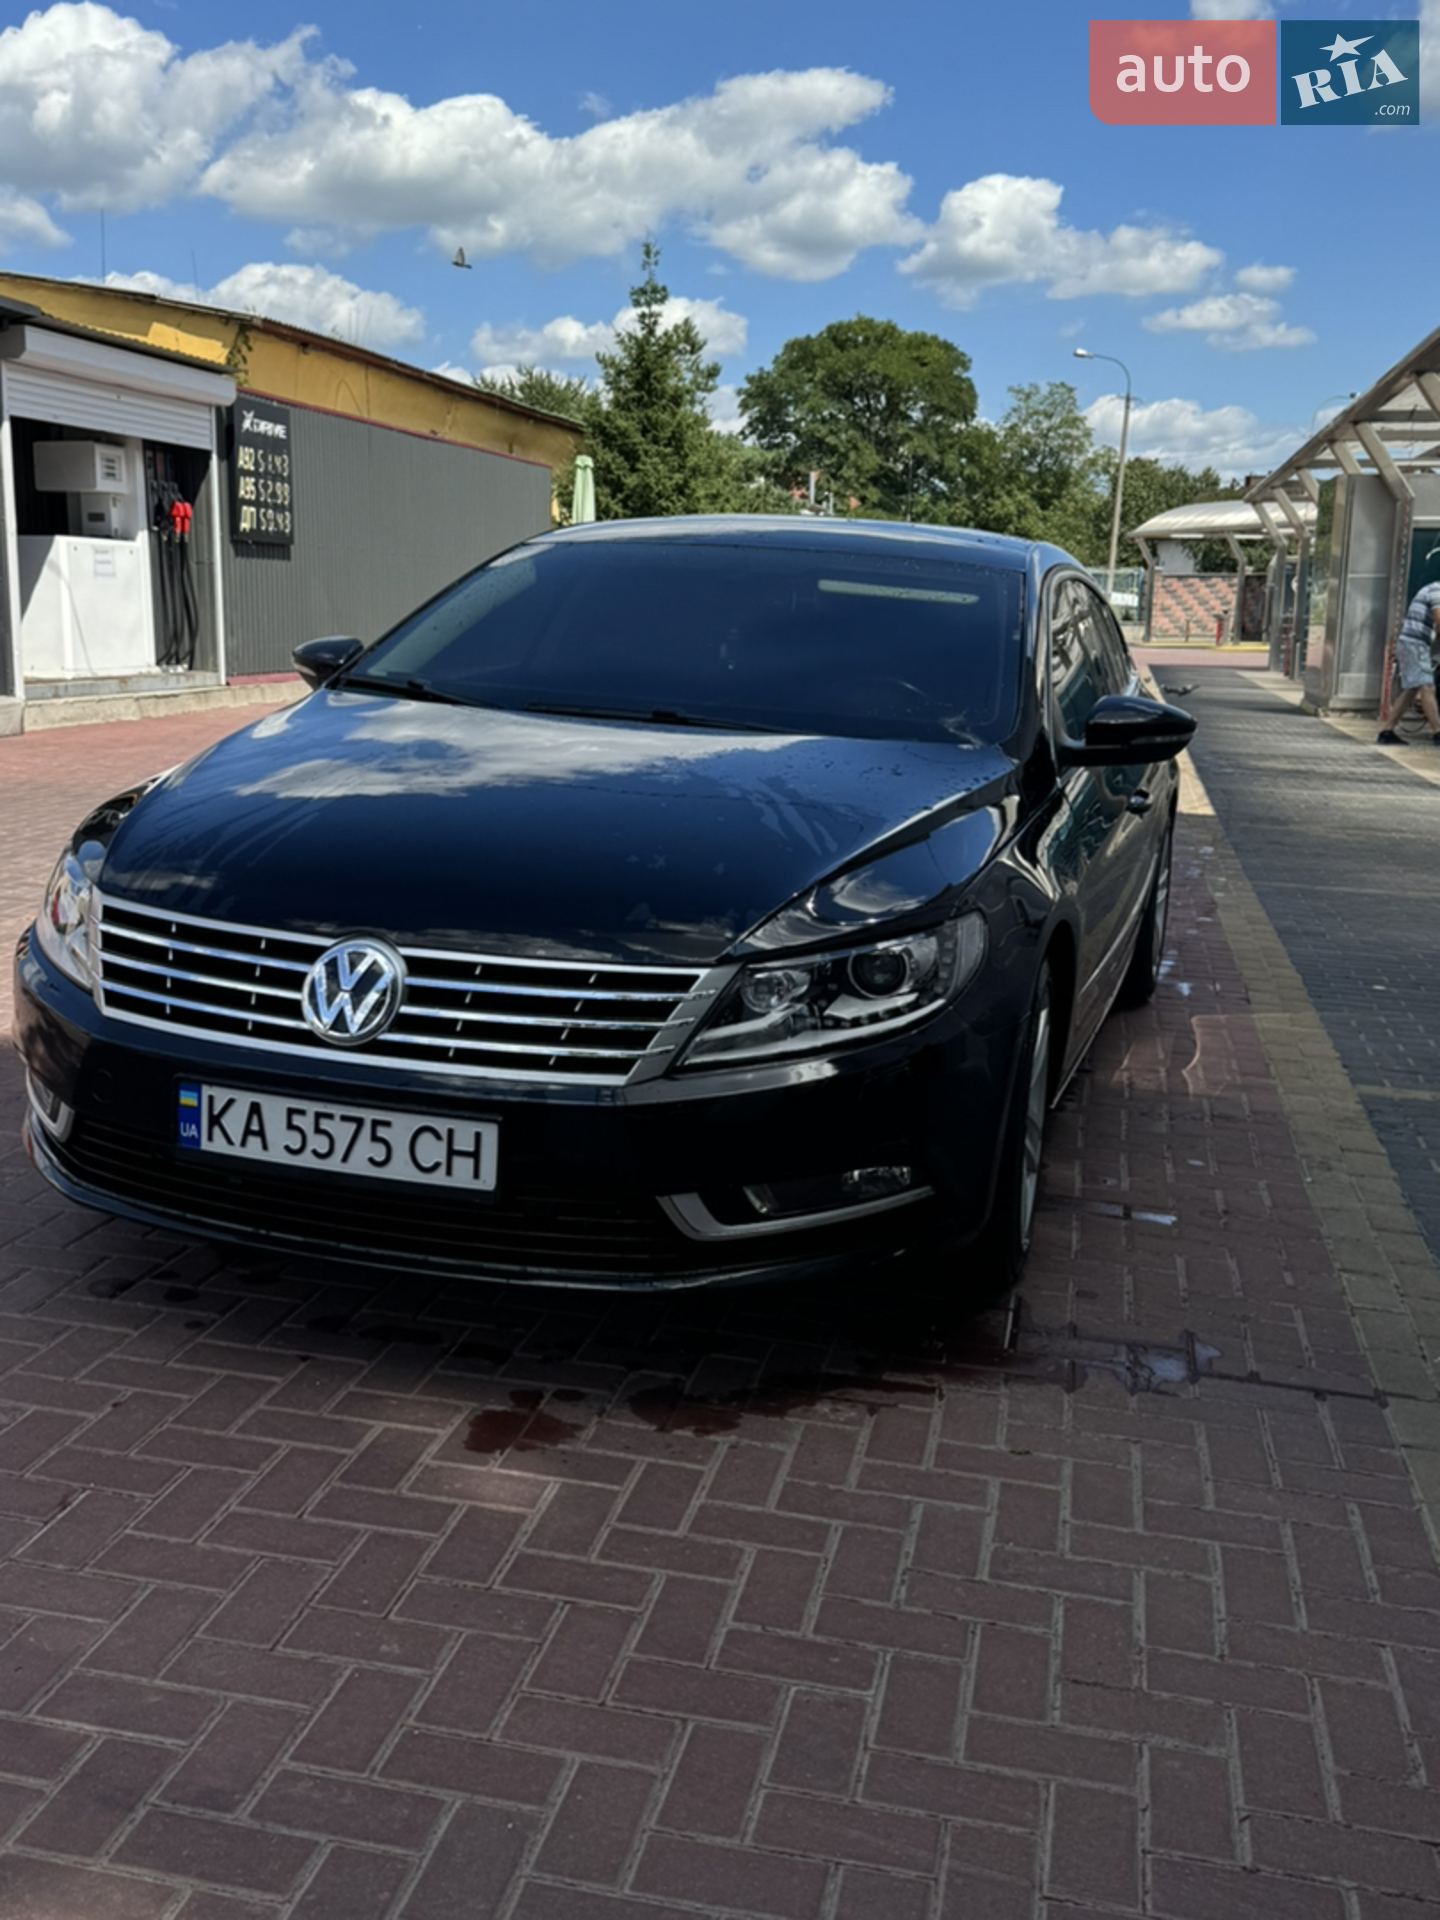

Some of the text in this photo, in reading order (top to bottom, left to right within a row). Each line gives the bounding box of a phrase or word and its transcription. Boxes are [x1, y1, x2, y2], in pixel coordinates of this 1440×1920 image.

[180, 1121, 198, 1139] UA
[207, 1094, 483, 1180] KA 5575 CH
